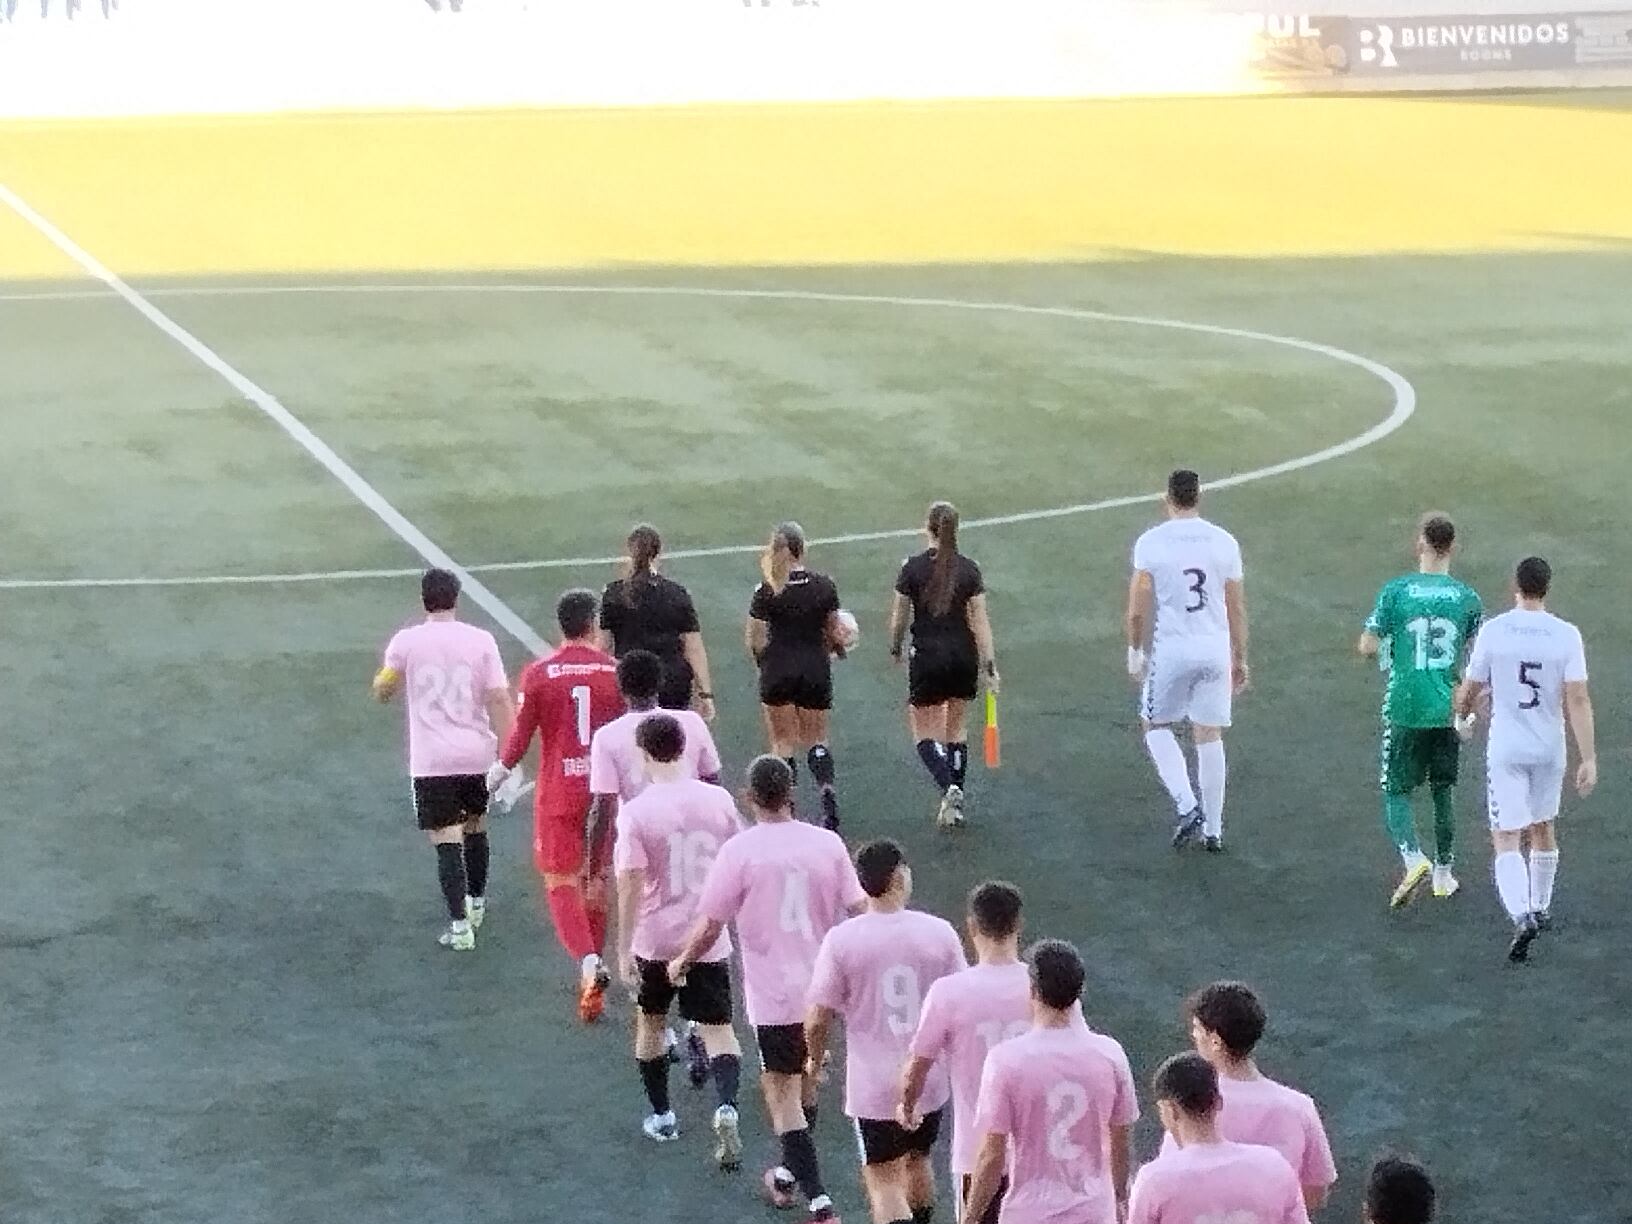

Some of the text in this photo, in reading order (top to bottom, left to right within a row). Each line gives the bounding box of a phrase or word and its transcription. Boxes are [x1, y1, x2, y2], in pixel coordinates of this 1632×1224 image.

[1401, 22, 1569, 47] BIENVENIDOS
[1183, 567, 1208, 613] 3
[1405, 615, 1458, 671] 13
[1517, 661, 1543, 709] 5
[572, 685, 592, 746] 1
[882, 964, 921, 1039] 9
[1047, 1080, 1088, 1161] 2
